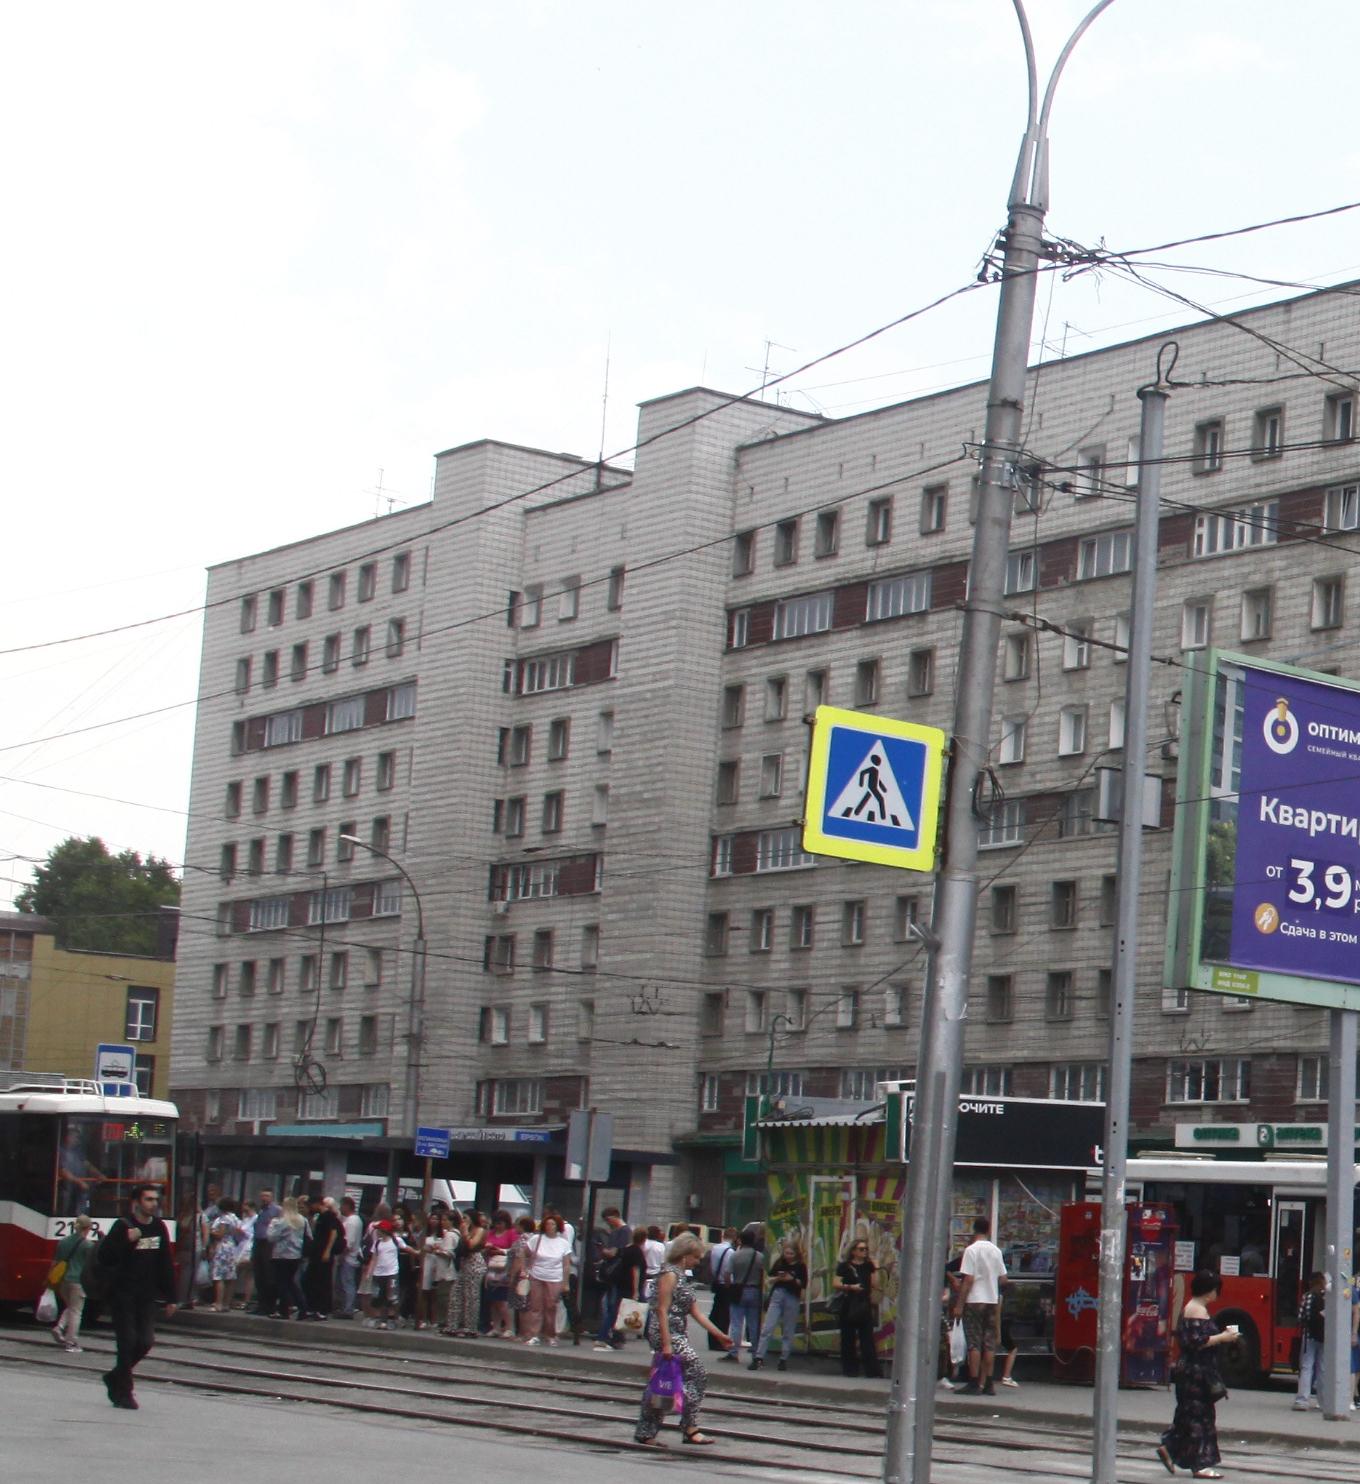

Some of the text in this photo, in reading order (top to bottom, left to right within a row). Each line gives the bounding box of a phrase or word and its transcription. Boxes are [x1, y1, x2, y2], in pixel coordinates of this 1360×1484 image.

[1307, 744, 1347, 759] СЕМЕЙНЫЙ
[1266, 865, 1283, 879] от
[1288, 858, 1352, 911] 3,9
[1280, 922, 1316, 939] Сдача
[1319, 929, 1326, 939] в
[1329, 931, 1357, 944] этом
[957, 1102, 1005, 1115] ЮЧИТЕ
[55, 1220, 101, 1238] 219
